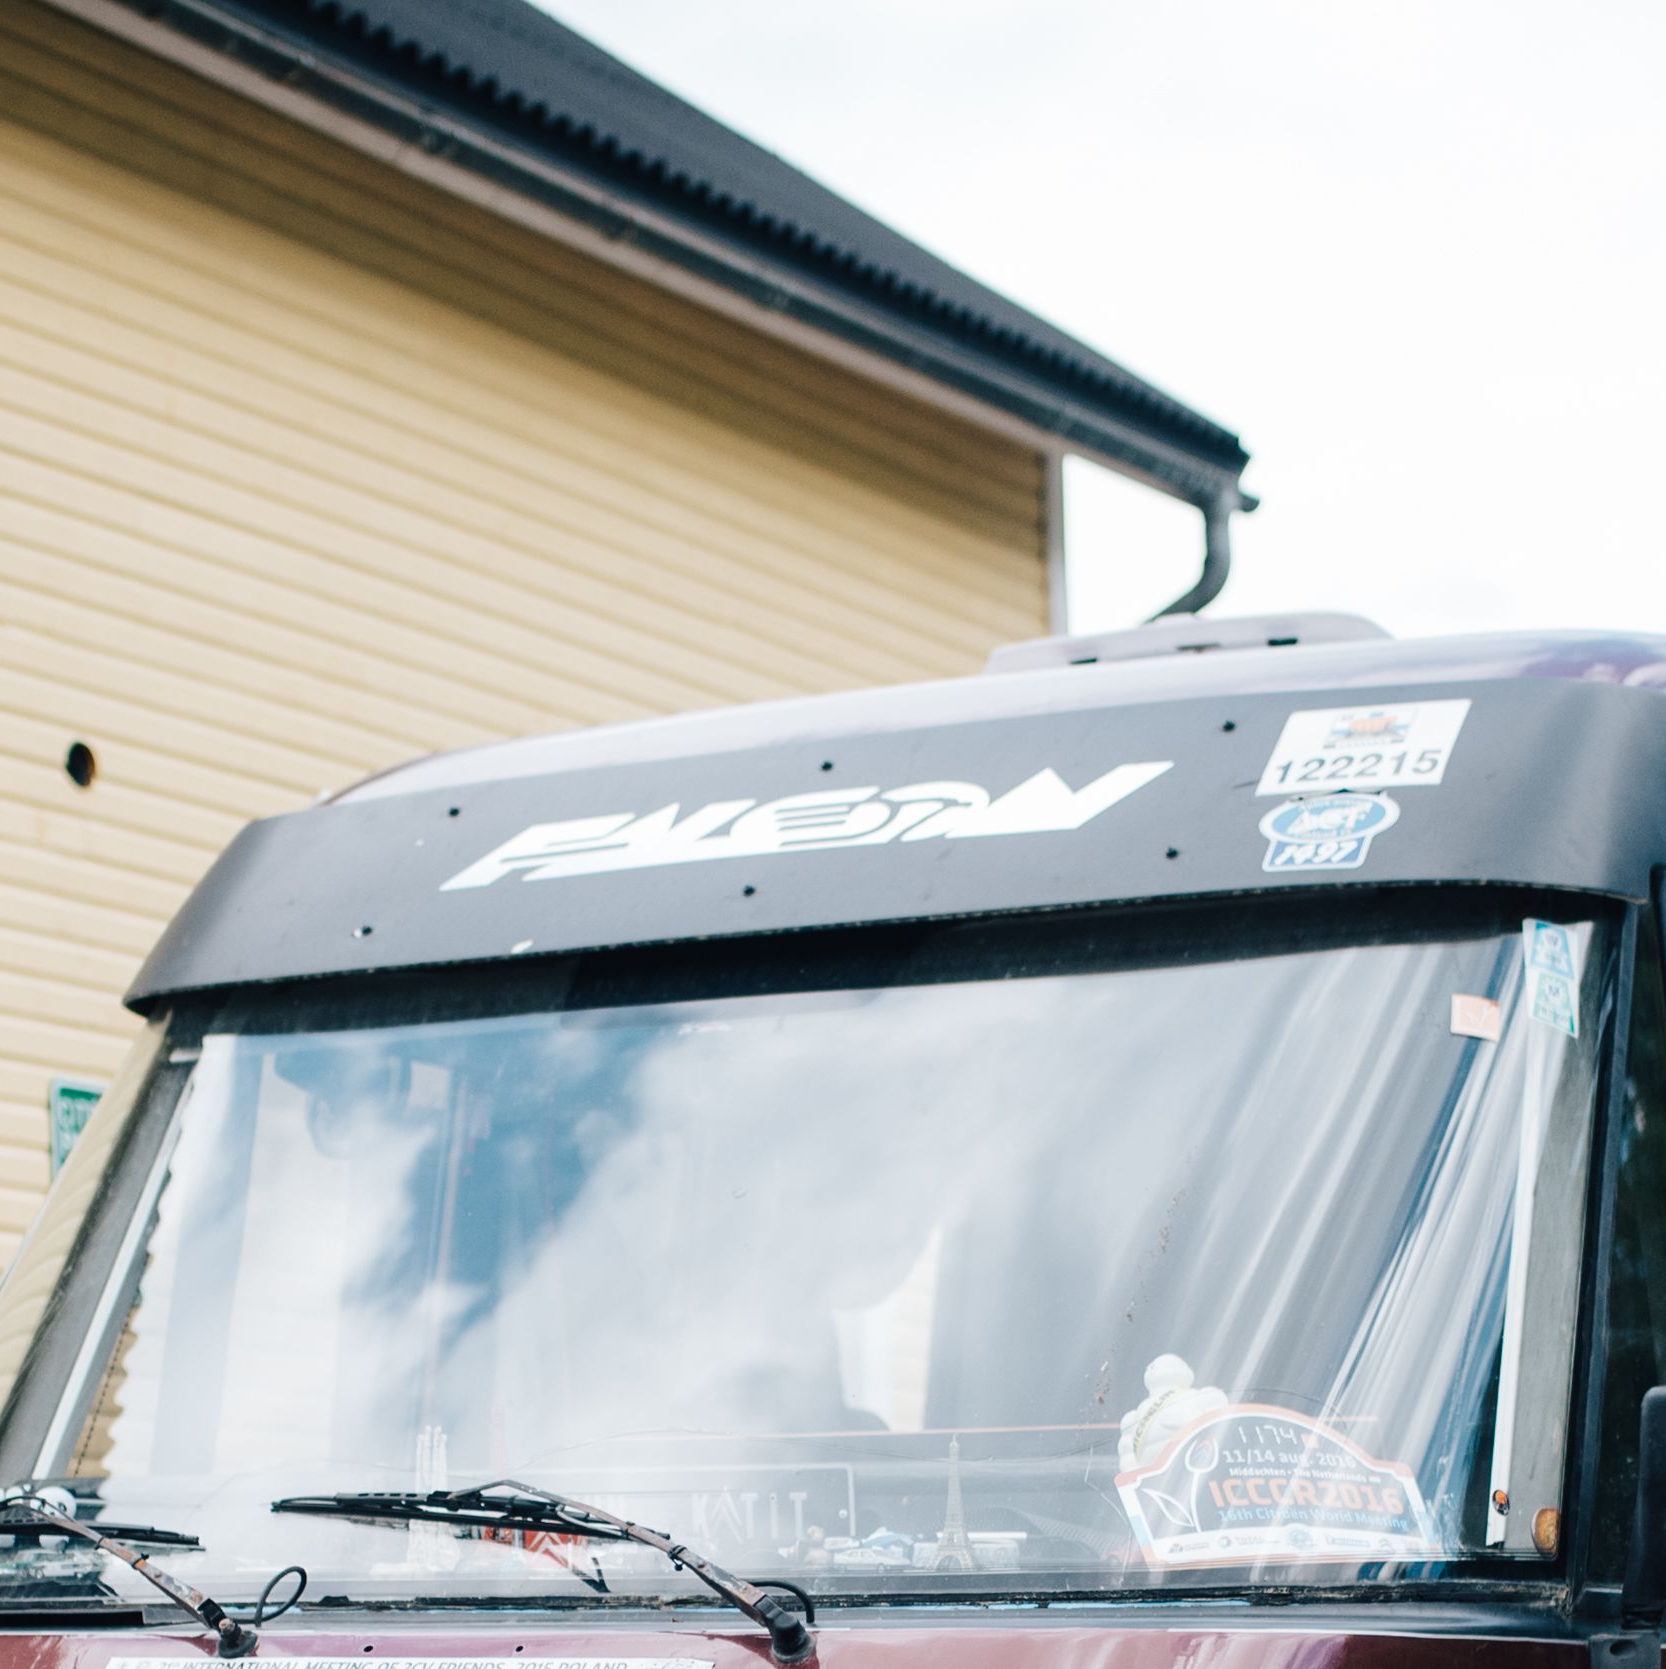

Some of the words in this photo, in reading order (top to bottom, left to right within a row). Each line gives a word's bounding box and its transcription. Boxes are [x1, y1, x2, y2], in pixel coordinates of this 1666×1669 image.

[1276, 749, 1442, 784] 122215
[1222, 1450, 1275, 1465] 11/14
[1218, 1508, 1253, 1522] 16th
[1310, 1509, 1352, 1524] World
